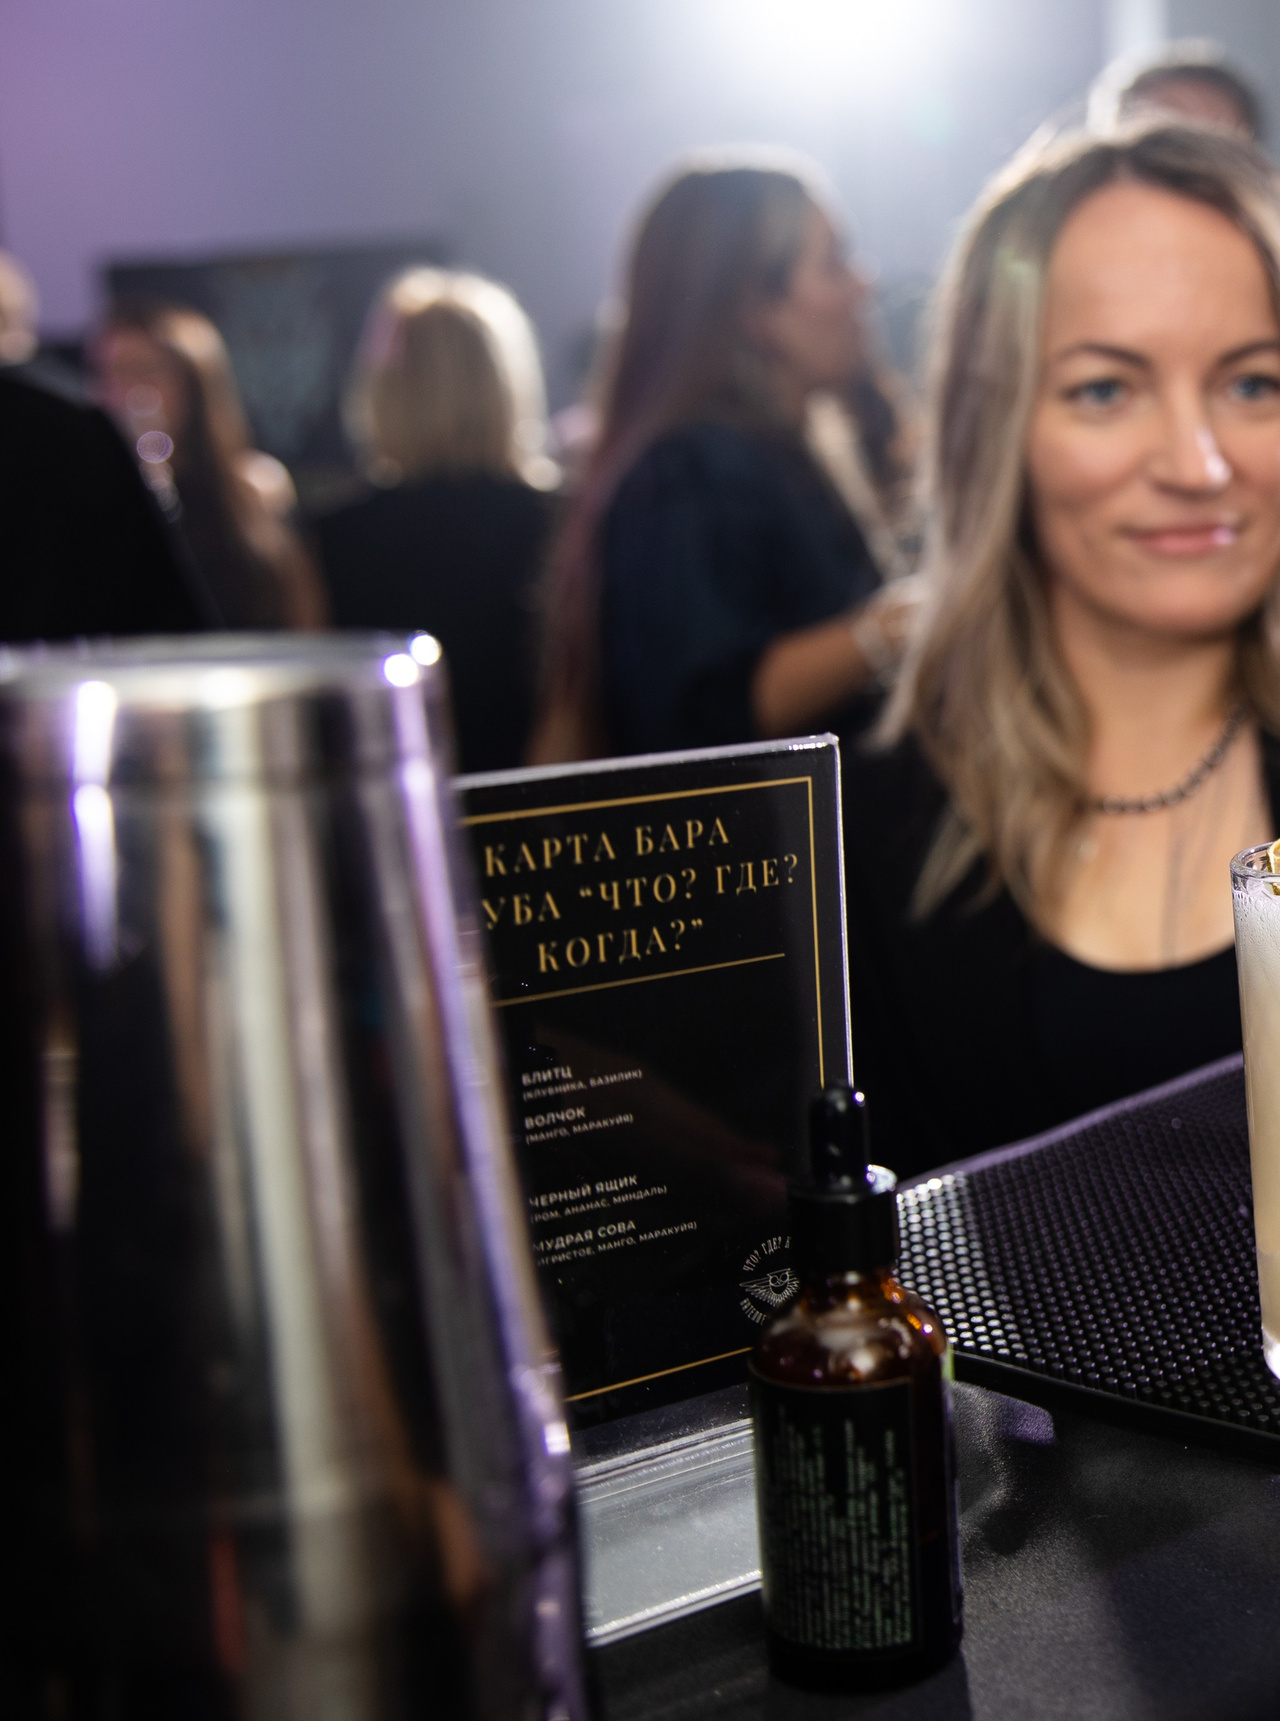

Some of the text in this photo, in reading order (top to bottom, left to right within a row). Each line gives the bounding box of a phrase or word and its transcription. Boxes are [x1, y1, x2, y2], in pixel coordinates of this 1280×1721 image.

[484, 817, 730, 877] КАРТА БАРА
[714, 852, 799, 896] ГДЕ?
[524, 1106, 586, 1130] ВОЛЧОК
[529, 1174, 638, 1208] ЧЕРНЫЙ ЯЩИК
[597, 1219, 637, 1238] СОВА
